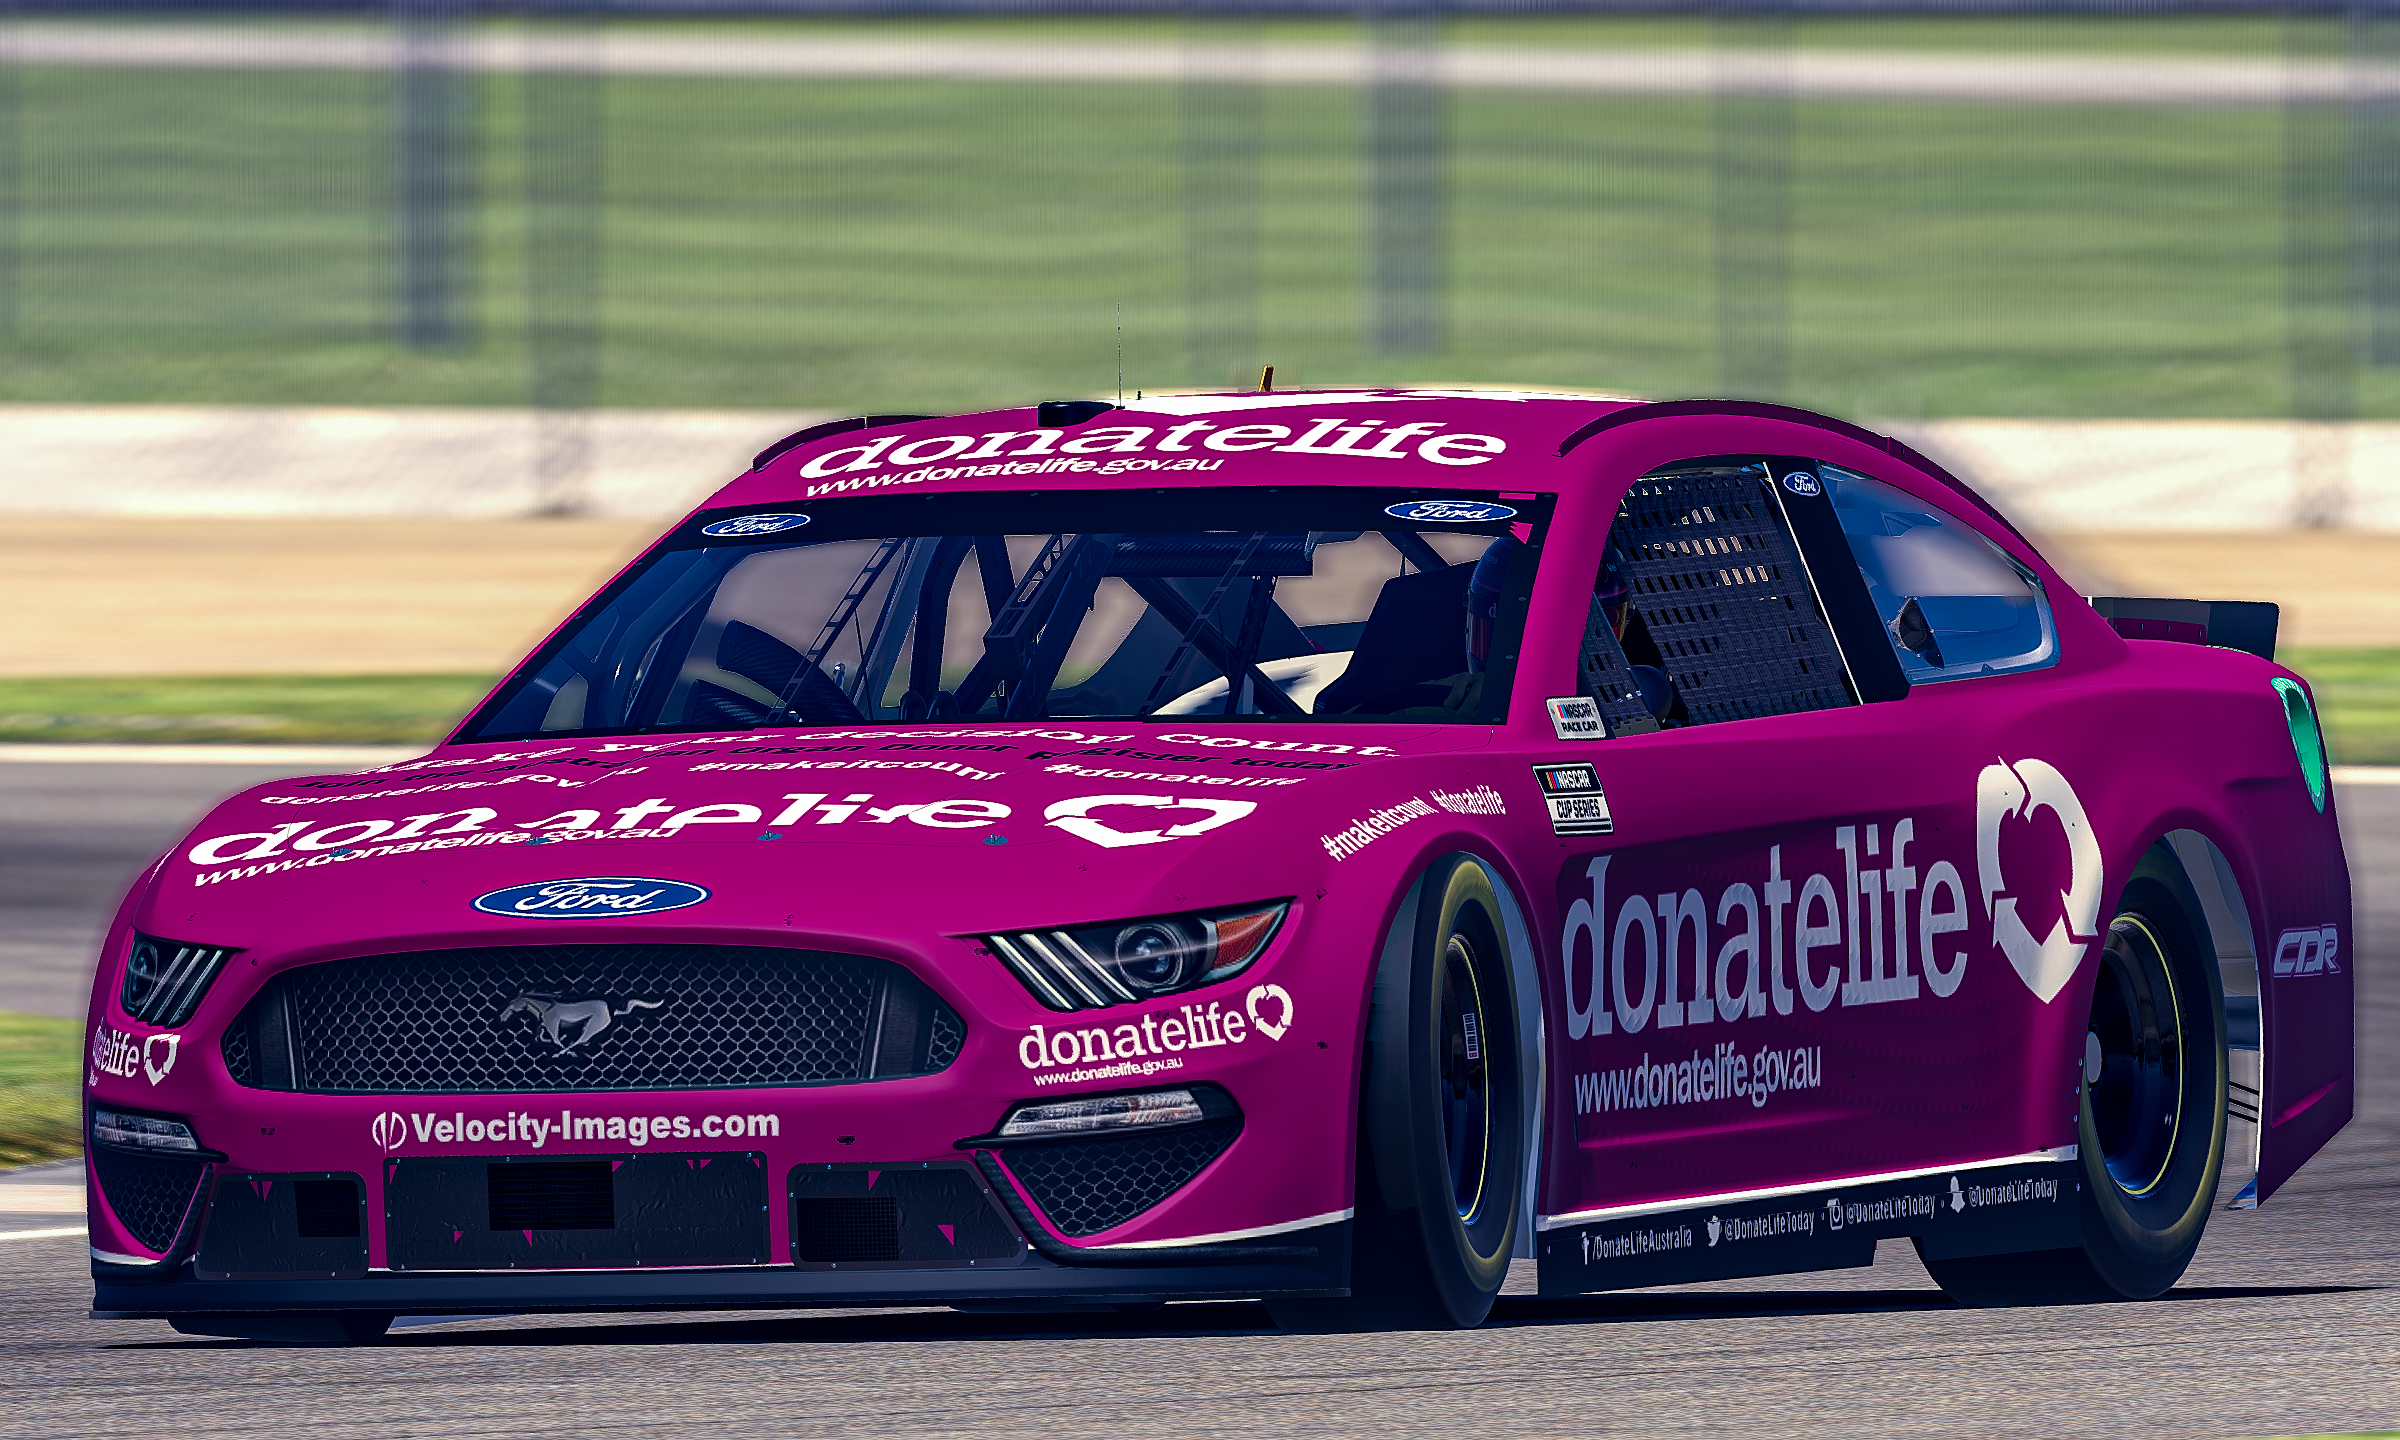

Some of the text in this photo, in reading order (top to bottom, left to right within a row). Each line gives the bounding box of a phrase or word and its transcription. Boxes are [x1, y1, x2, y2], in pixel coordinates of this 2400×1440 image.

[799, 417, 1506, 479] donatelife
[807, 457, 1226, 497] www.donatelife.gov.au
[1563, 703, 1594, 718] NASCAR
[1561, 720, 1599, 733] RACE CAR
[589, 734, 785, 752] yur
[728, 746, 867, 756] Organ
[876, 742, 1019, 753] Donor
[688, 759, 1006, 781] #makeitcount
[1043, 763, 1307, 787] #donatelife
[1556, 770, 1591, 789] NASCAR
[1556, 799, 1601, 818] CUP SERIES
[1562, 817, 1970, 1040] donatelife
[2273, 923, 2341, 978] CDR
[1019, 1002, 1247, 1069] donatelife
[1033, 1056, 1183, 1087] www.donatelife.gov.au
[1574, 1040, 1822, 1115] www.donatelife.gov.au
[411, 1110, 780, 1148] Velocity-Images.com
[1724, 1211, 1815, 1241] @DonateLifeToday
